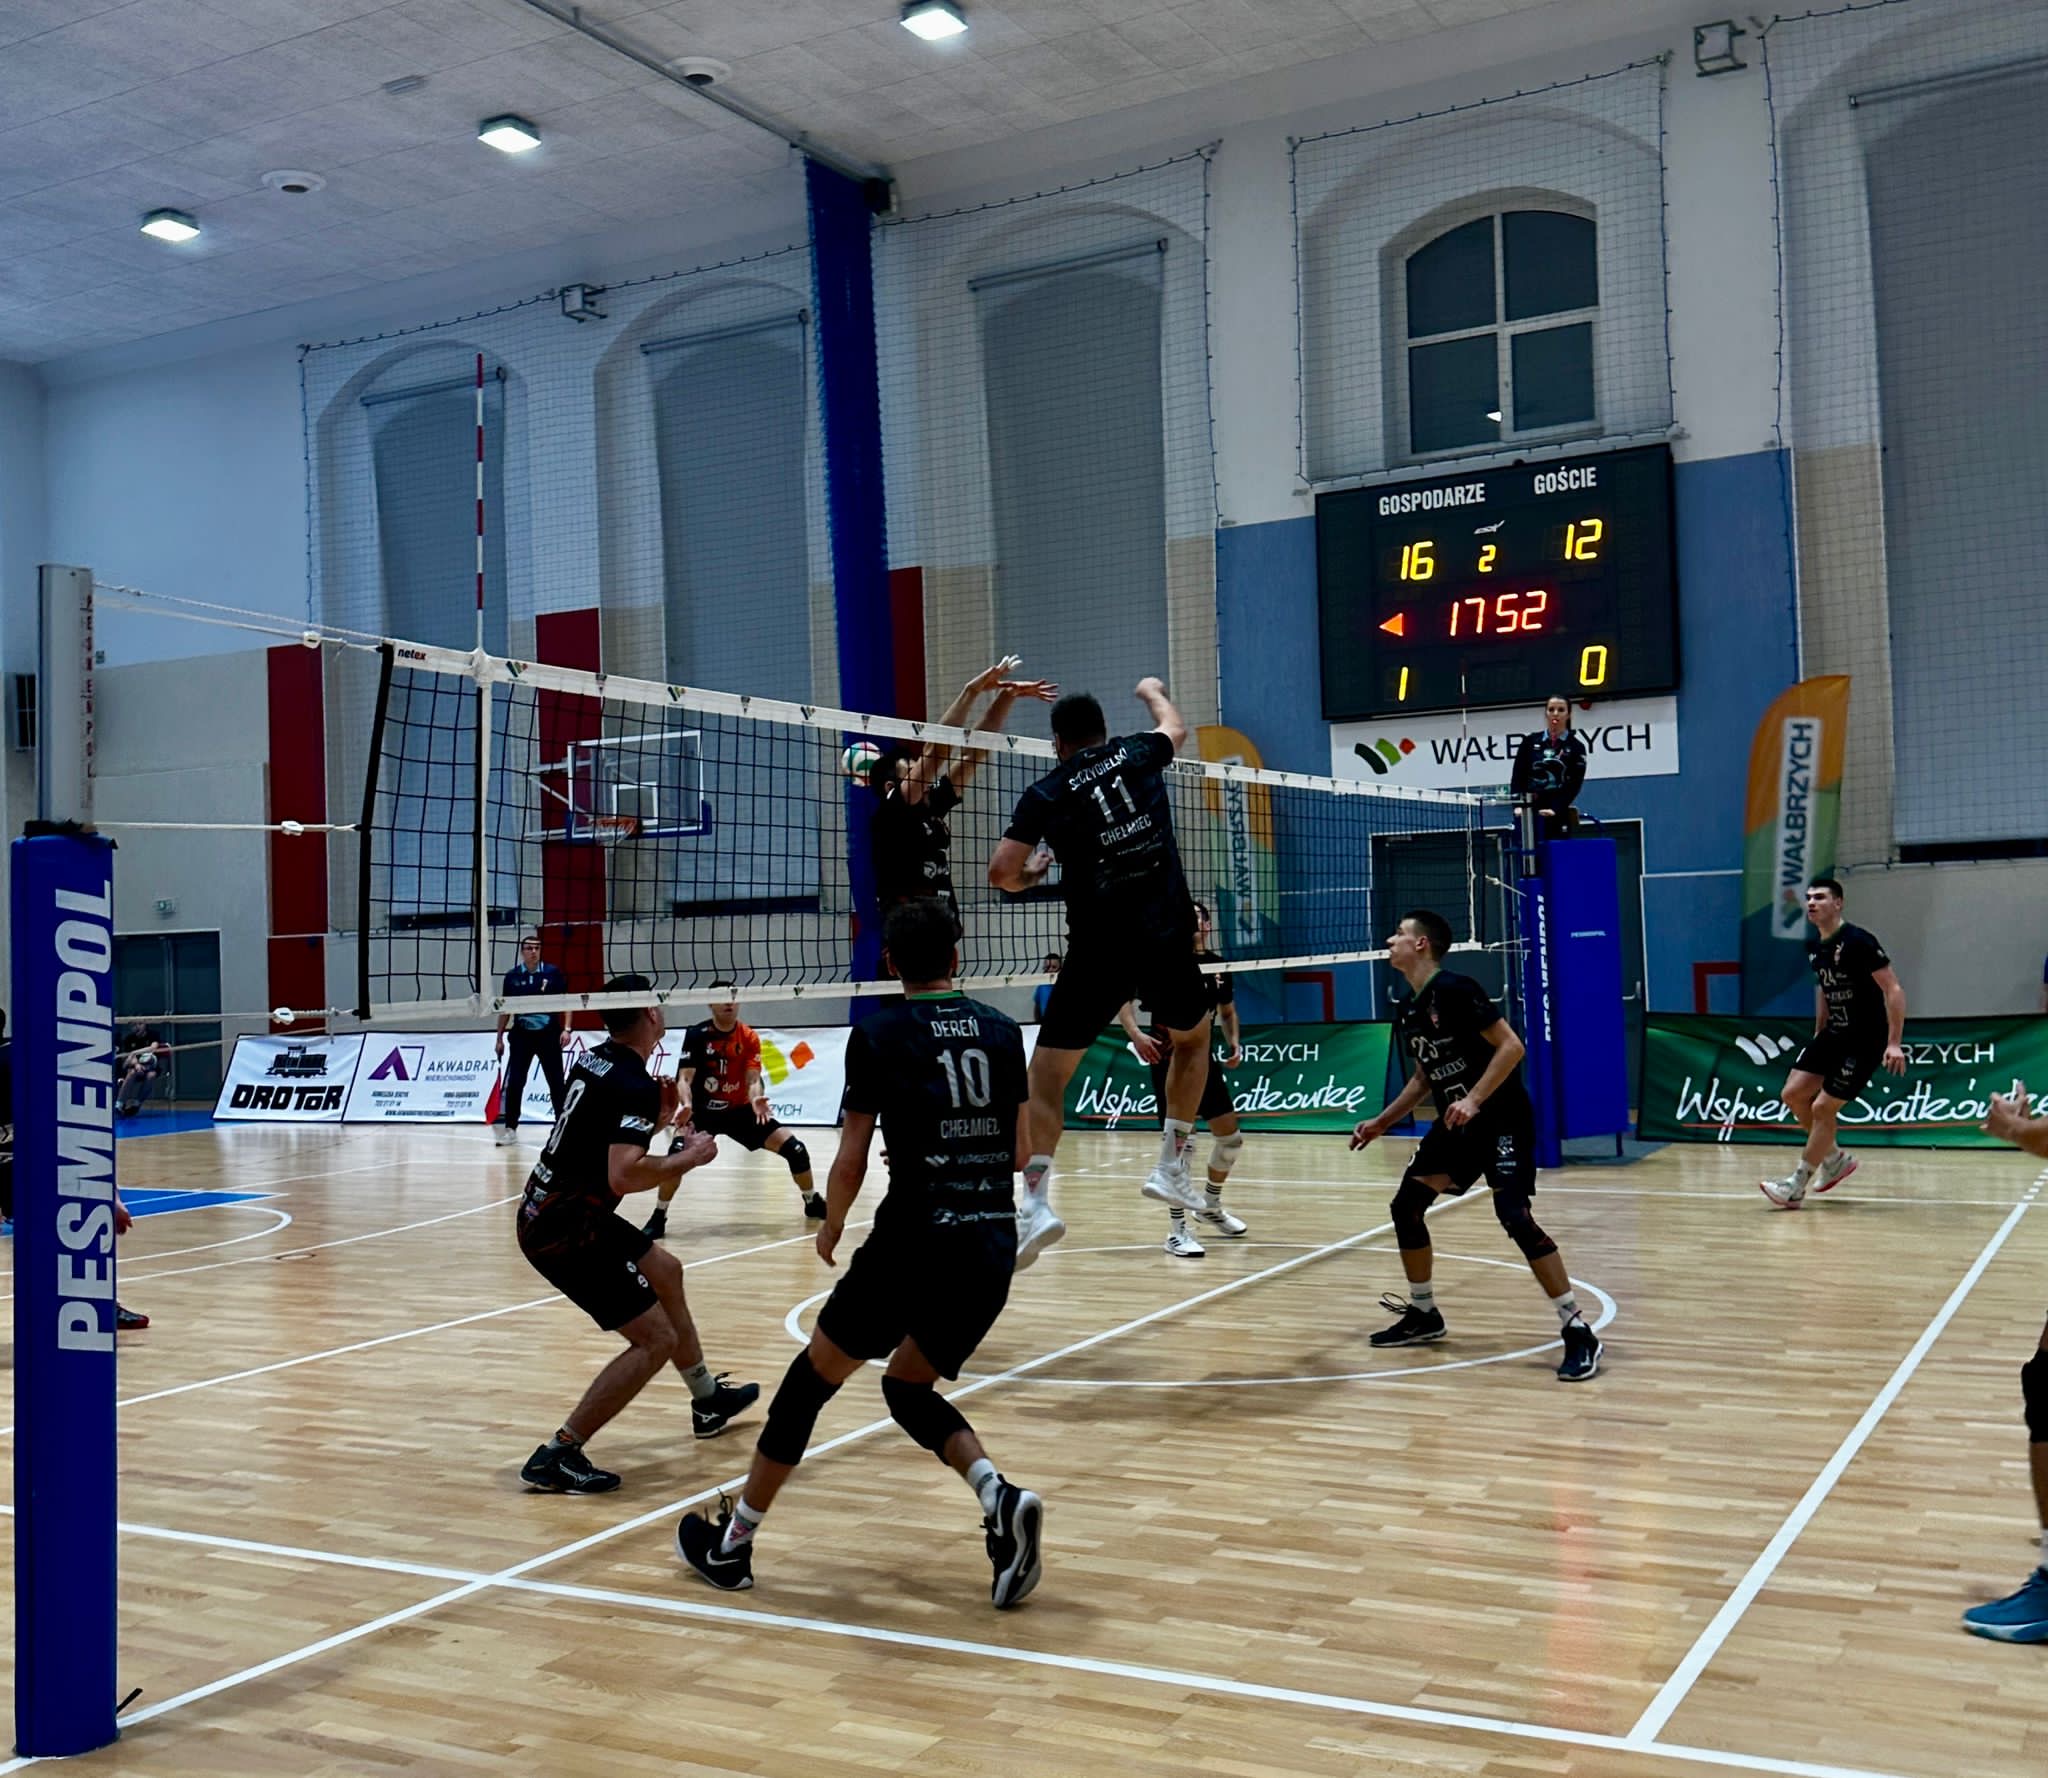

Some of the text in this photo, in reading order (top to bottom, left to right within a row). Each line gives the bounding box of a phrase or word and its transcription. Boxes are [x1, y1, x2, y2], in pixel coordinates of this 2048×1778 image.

[1379, 482, 1486, 516] GOSPODARZE
[1533, 466, 1597, 495] GOŚCIE
[1564, 518, 1603, 560] 12
[1400, 541, 1434, 580] 16
[1478, 544, 1496, 572] 2
[397, 648, 426, 660] netex
[1578, 645, 1607, 686] 0
[1398, 666, 1408, 701] 1
[1431, 723, 1652, 765] WAŁBYCH
[1090, 775, 1136, 823] 11
[1781, 722, 1813, 887] WAŁBRZYCH
[930, 1015, 980, 1038] DEREŃ
[427, 1060, 497, 1072] AKWADRAT
[1212, 1043, 1319, 1063] ŁRZYCH
[1900, 1043, 1995, 1064] RZYCH
[936, 1048, 991, 1108] 10
[55, 880, 114, 1352] PESMENPOL
[527, 1093, 551, 1103] AKAD
[1074, 1073, 1366, 1129] Wspie atkówkę
[1675, 1076, 1801, 1142] Wspier
